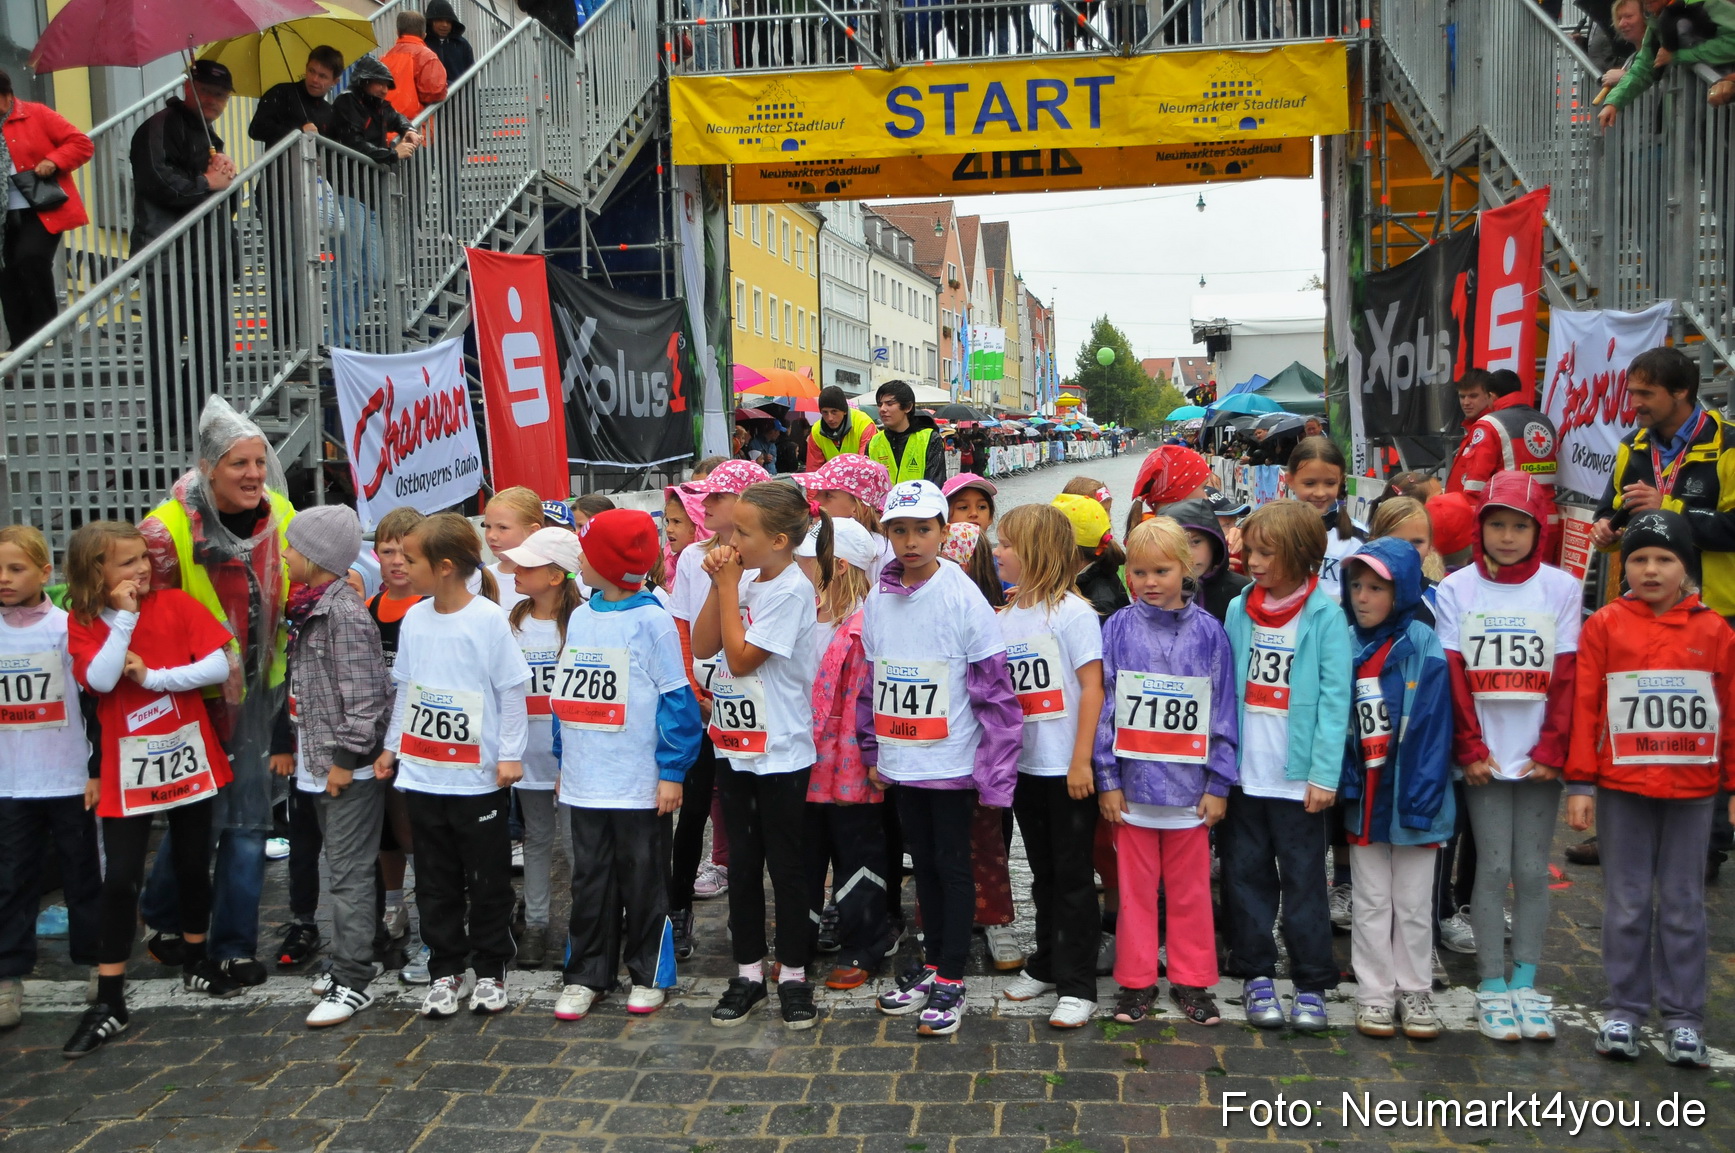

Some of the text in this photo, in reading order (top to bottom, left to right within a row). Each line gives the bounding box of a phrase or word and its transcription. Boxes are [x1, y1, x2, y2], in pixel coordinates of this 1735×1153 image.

[885, 75, 1115, 138] START
[1158, 96, 1307, 114] Neumarkter Stadtlauf
[706, 118, 845, 134] Neumarkter Stadtlauf
[1156, 144, 1283, 162] Neumarkter Stadtlauf
[759, 164, 880, 179] Neumarkter Stadtlauf
[353, 357, 469, 501] Charivari
[395, 451, 479, 498] Ostbayerns Radio
[1485, 617, 1526, 627] BOCK
[575, 653, 603, 663] BOCK
[1007, 643, 1029, 656] OCK
[1469, 634, 1545, 667] 7153
[1, 659, 30, 669] OCK
[887, 665, 918, 677] BOCK
[1, 672, 51, 703] 107
[561, 668, 617, 701] 7268
[1142, 679, 1184, 692] BOCK
[1475, 671, 1547, 691] VICTORIA
[1638, 676, 1685, 687] BOCK
[421, 691, 453, 705] BOCK
[878, 681, 938, 716] 7147
[2, 708, 36, 720] Paula
[138, 706, 159, 722] DEHN
[716, 699, 757, 729] 139
[1126, 695, 1199, 731] 7188
[1620, 695, 1707, 730] 7066
[411, 703, 470, 742] 7263
[890, 721, 917, 737] Julia
[722, 735, 739, 748] Eva
[1636, 737, 1696, 752] Mariella
[132, 745, 199, 786] 7123
[151, 784, 191, 802] Karina
